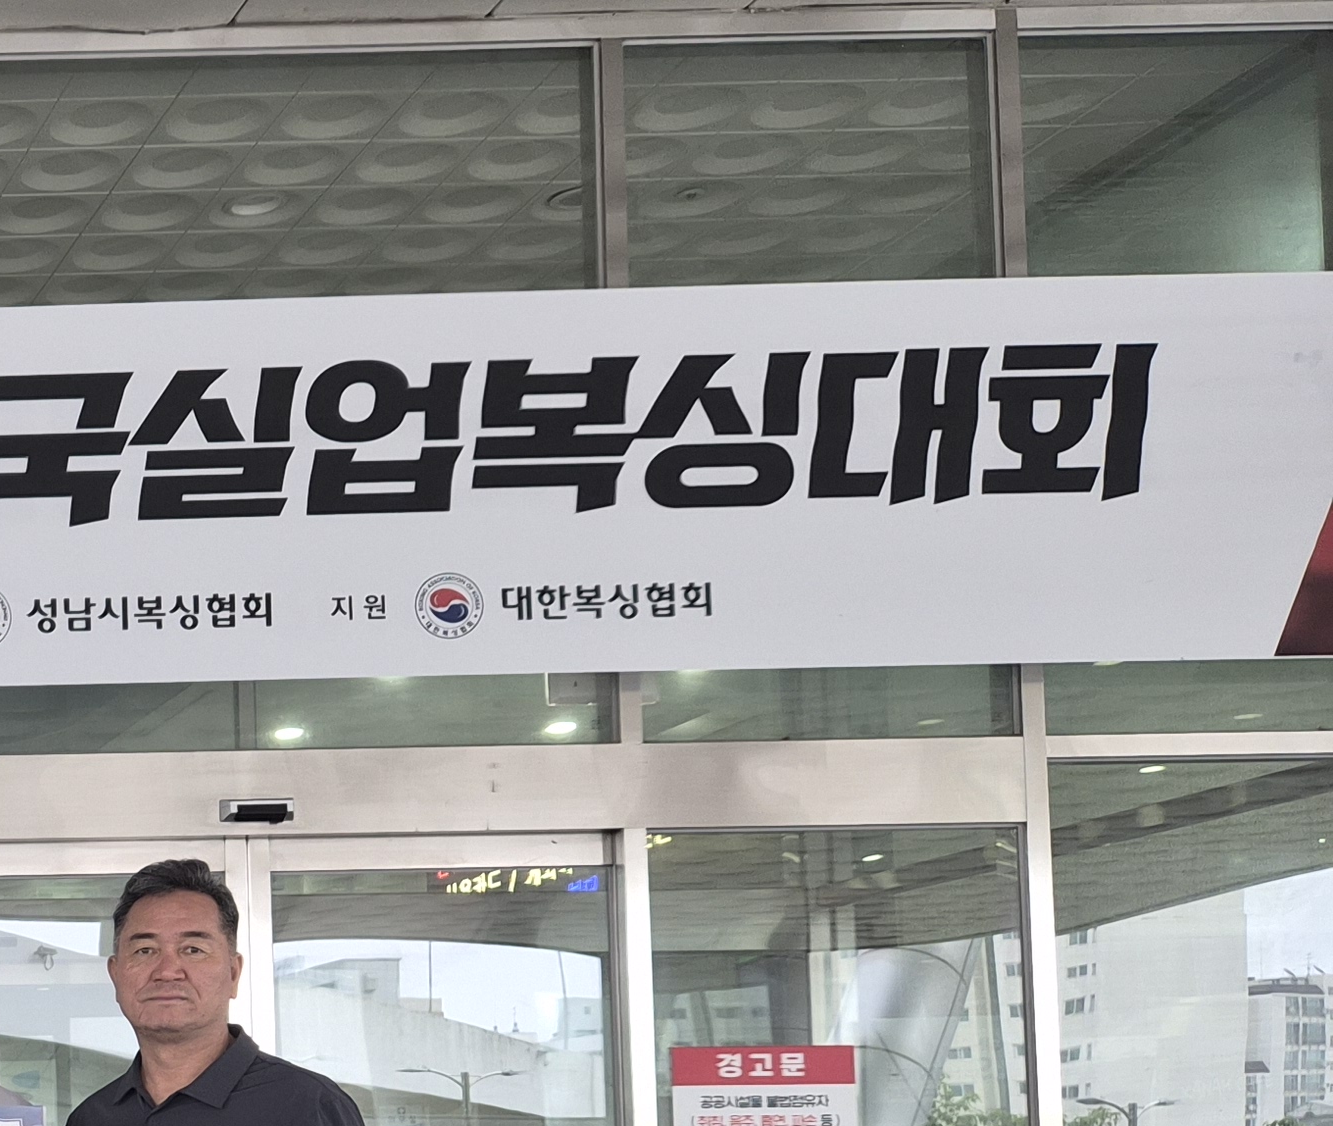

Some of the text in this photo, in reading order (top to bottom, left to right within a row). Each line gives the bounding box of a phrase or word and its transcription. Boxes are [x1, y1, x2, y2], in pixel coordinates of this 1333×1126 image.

[28, 592, 272, 634] 성남시복싱협회
[331, 582, 712, 621] 지원 대한복싱협회
[716, 1052, 806, 1078] 경고문
